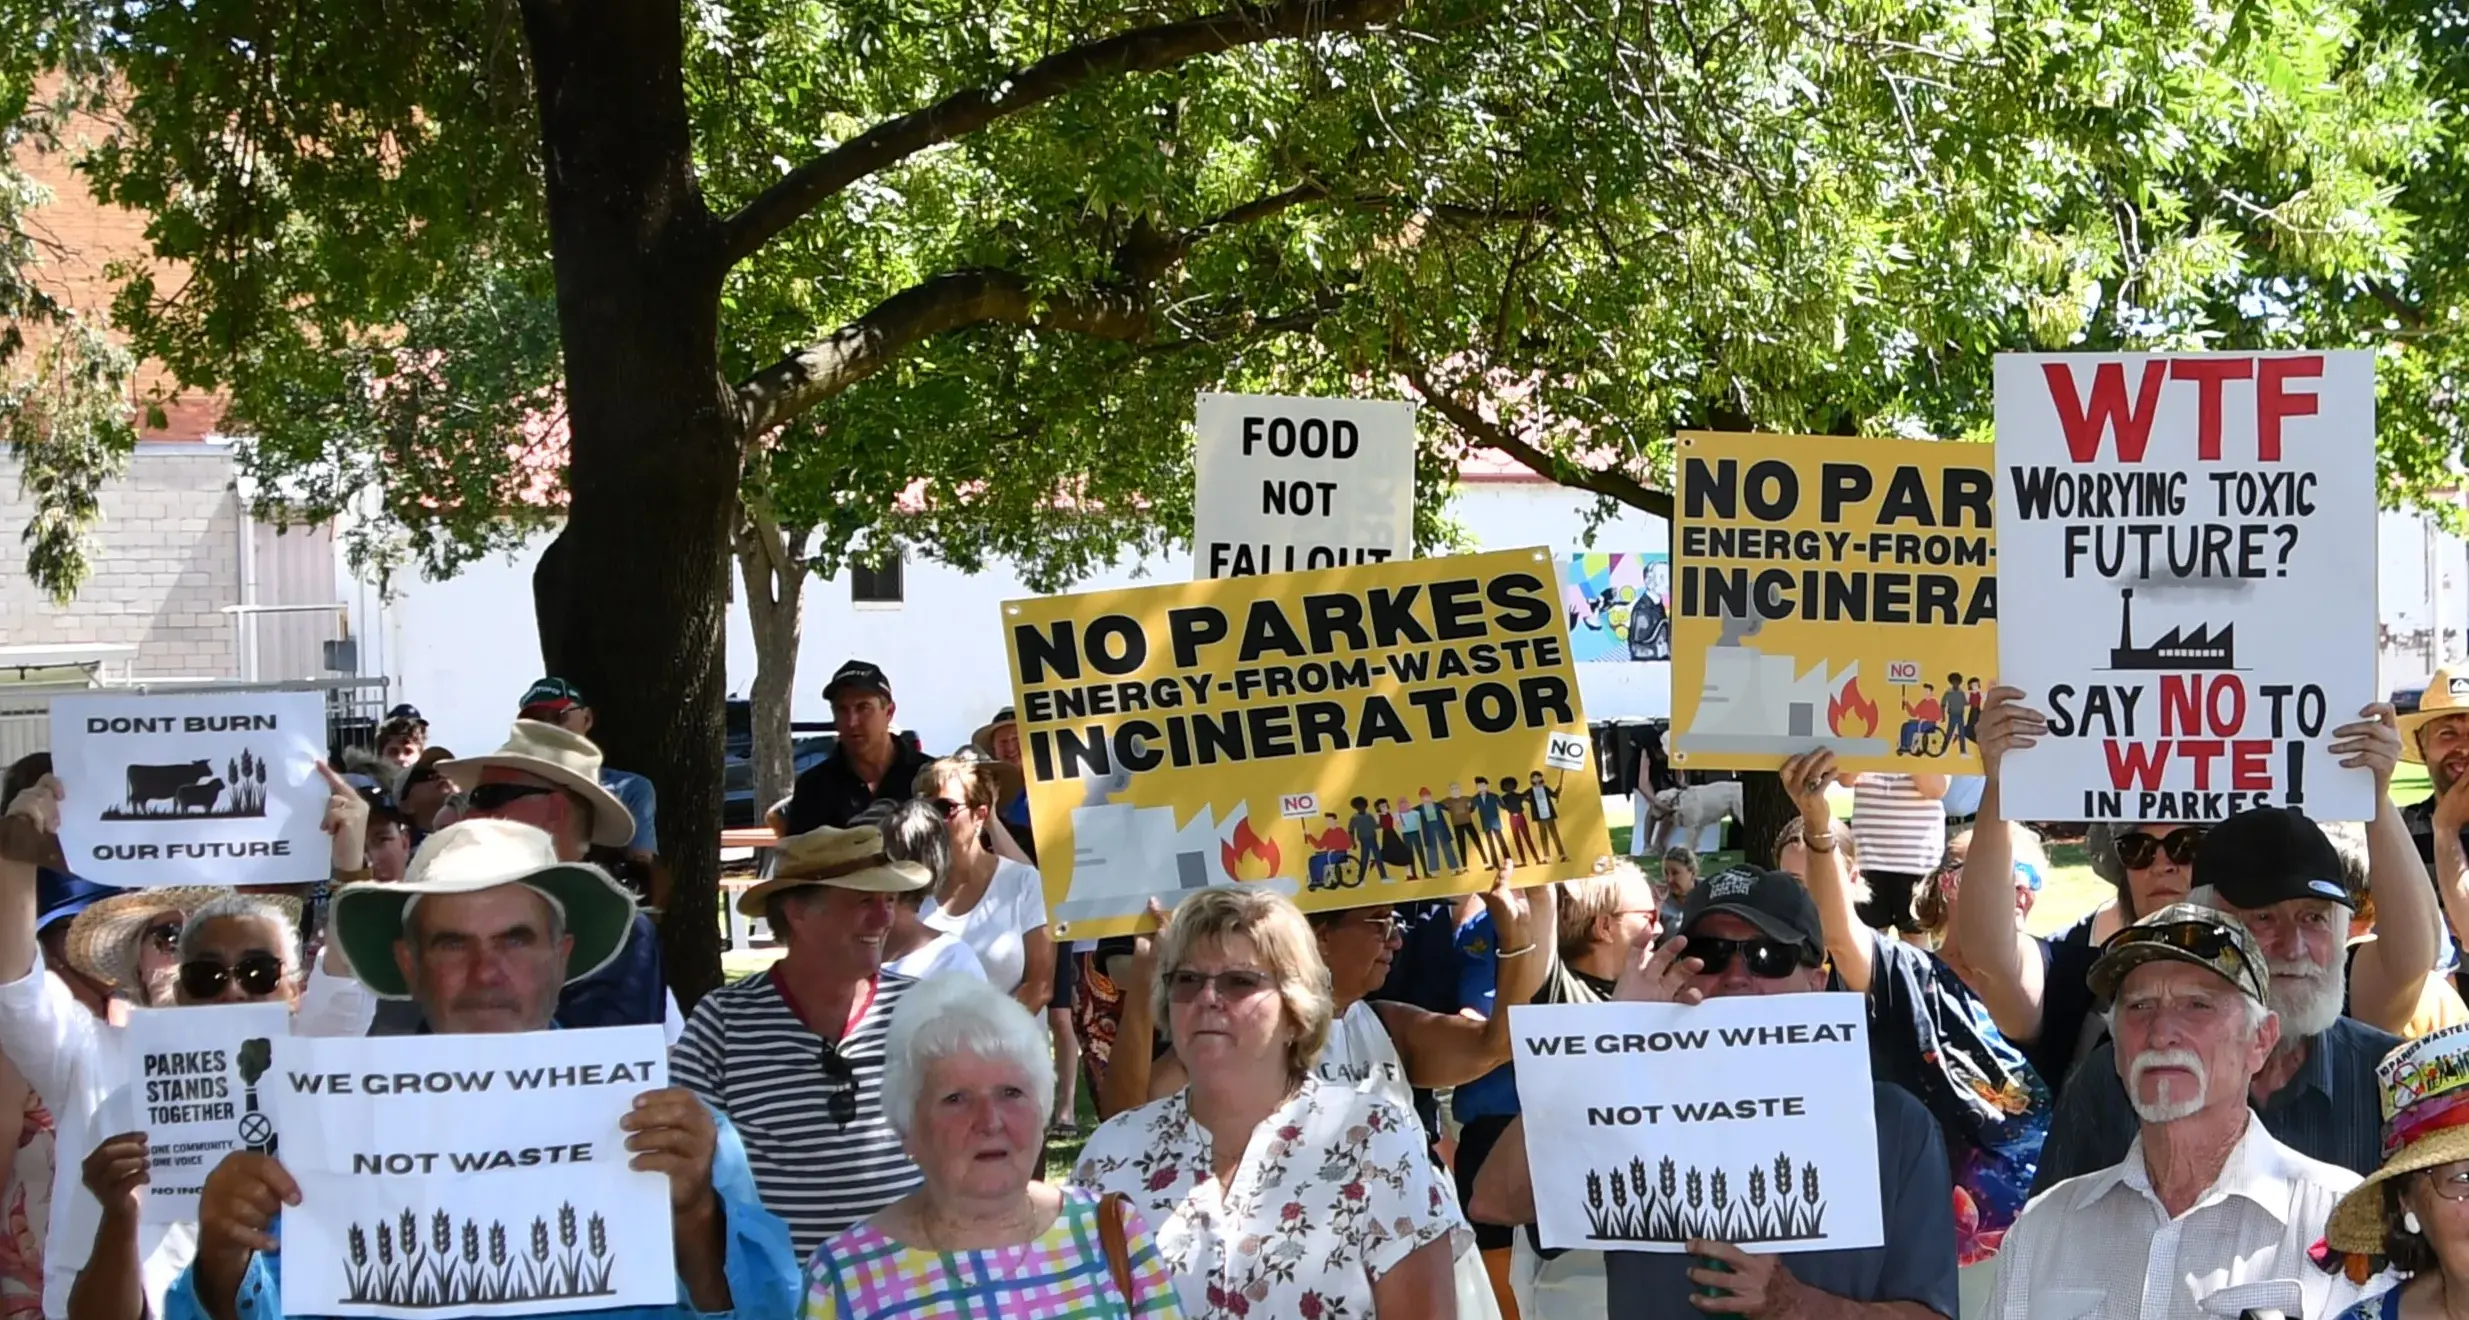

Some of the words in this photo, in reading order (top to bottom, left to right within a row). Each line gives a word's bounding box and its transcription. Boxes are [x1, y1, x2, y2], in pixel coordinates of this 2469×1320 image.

[2041, 356, 2324, 463] WTF
[1243, 416, 1359, 459] FOOD
[1262, 480, 1338, 516] NOT
[1684, 457, 1799, 522] NO
[1821, 462, 1994, 528] PAR
[2010, 466, 2188, 520] WORRYING
[2208, 471, 2318, 518] TOXIC
[1682, 526, 1996, 566] ENERGY-FROM-
[2064, 523, 2299, 579] FUTURE?
[1681, 566, 1997, 625] INCINERA
[1015, 614, 1147, 685] NO
[1168, 572, 1553, 667] PARKES
[1025, 637, 1562, 722] ENERGY-FROM-WASTE
[1891, 664, 1916, 677] NO
[2046, 684, 2144, 737] SAY
[2160, 673, 2246, 738] NO
[2259, 684, 2326, 738] TO
[87, 717, 176, 734] DONT
[184, 714, 277, 732] BURN
[1030, 675, 1574, 782] INCINERATOR
[1551, 739, 1584, 758] NO
[1284, 796, 1313, 811] NO
[2084, 790, 2121, 818] IN
[92, 844, 159, 860] OUR
[166, 840, 291, 859] FUTURE
[1525, 1035, 1587, 1057] WE
[1594, 1029, 1710, 1054] GROW
[1718, 1023, 1857, 1048] WHEAT
[2421, 1024, 2463, 1045] WASTE
[144, 1050, 227, 1077] PARKES
[287, 1070, 353, 1095] WE
[362, 1070, 495, 1095] GROW
[505, 1060, 656, 1091] WHEAT
[146, 1076, 228, 1103] STANDS
[147, 1102, 235, 1125] TOGETHER
[1588, 1105, 1664, 1126] NOT
[1672, 1096, 1805, 1123] WASTE
[151, 1144, 171, 1155] ONE
[151, 1156, 172, 1167] ONE
[174, 1155, 203, 1167] VOICE
[352, 1153, 439, 1175] NOT
[449, 1142, 593, 1173] WASTE
[151, 1186, 174, 1195] NO
